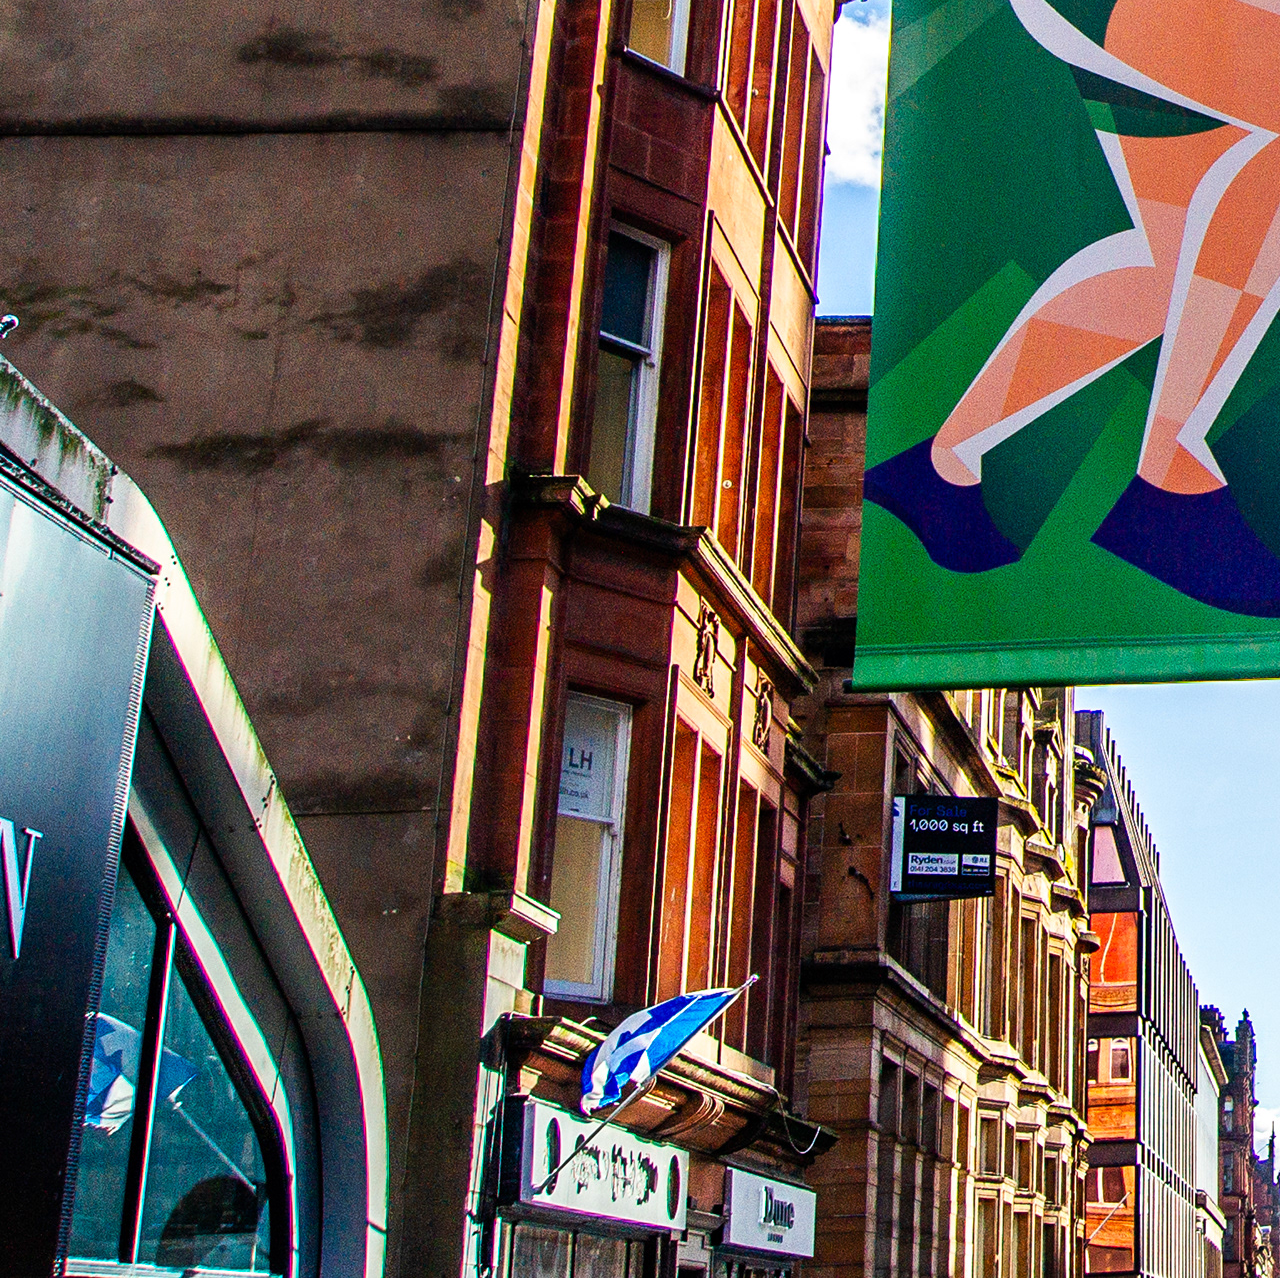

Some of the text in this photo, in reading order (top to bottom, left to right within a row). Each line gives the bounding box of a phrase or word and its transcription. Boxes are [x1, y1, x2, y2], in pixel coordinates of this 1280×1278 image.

[909, 804, 967, 817] For Sale
[909, 818, 985, 834] 1,000 sq ft
